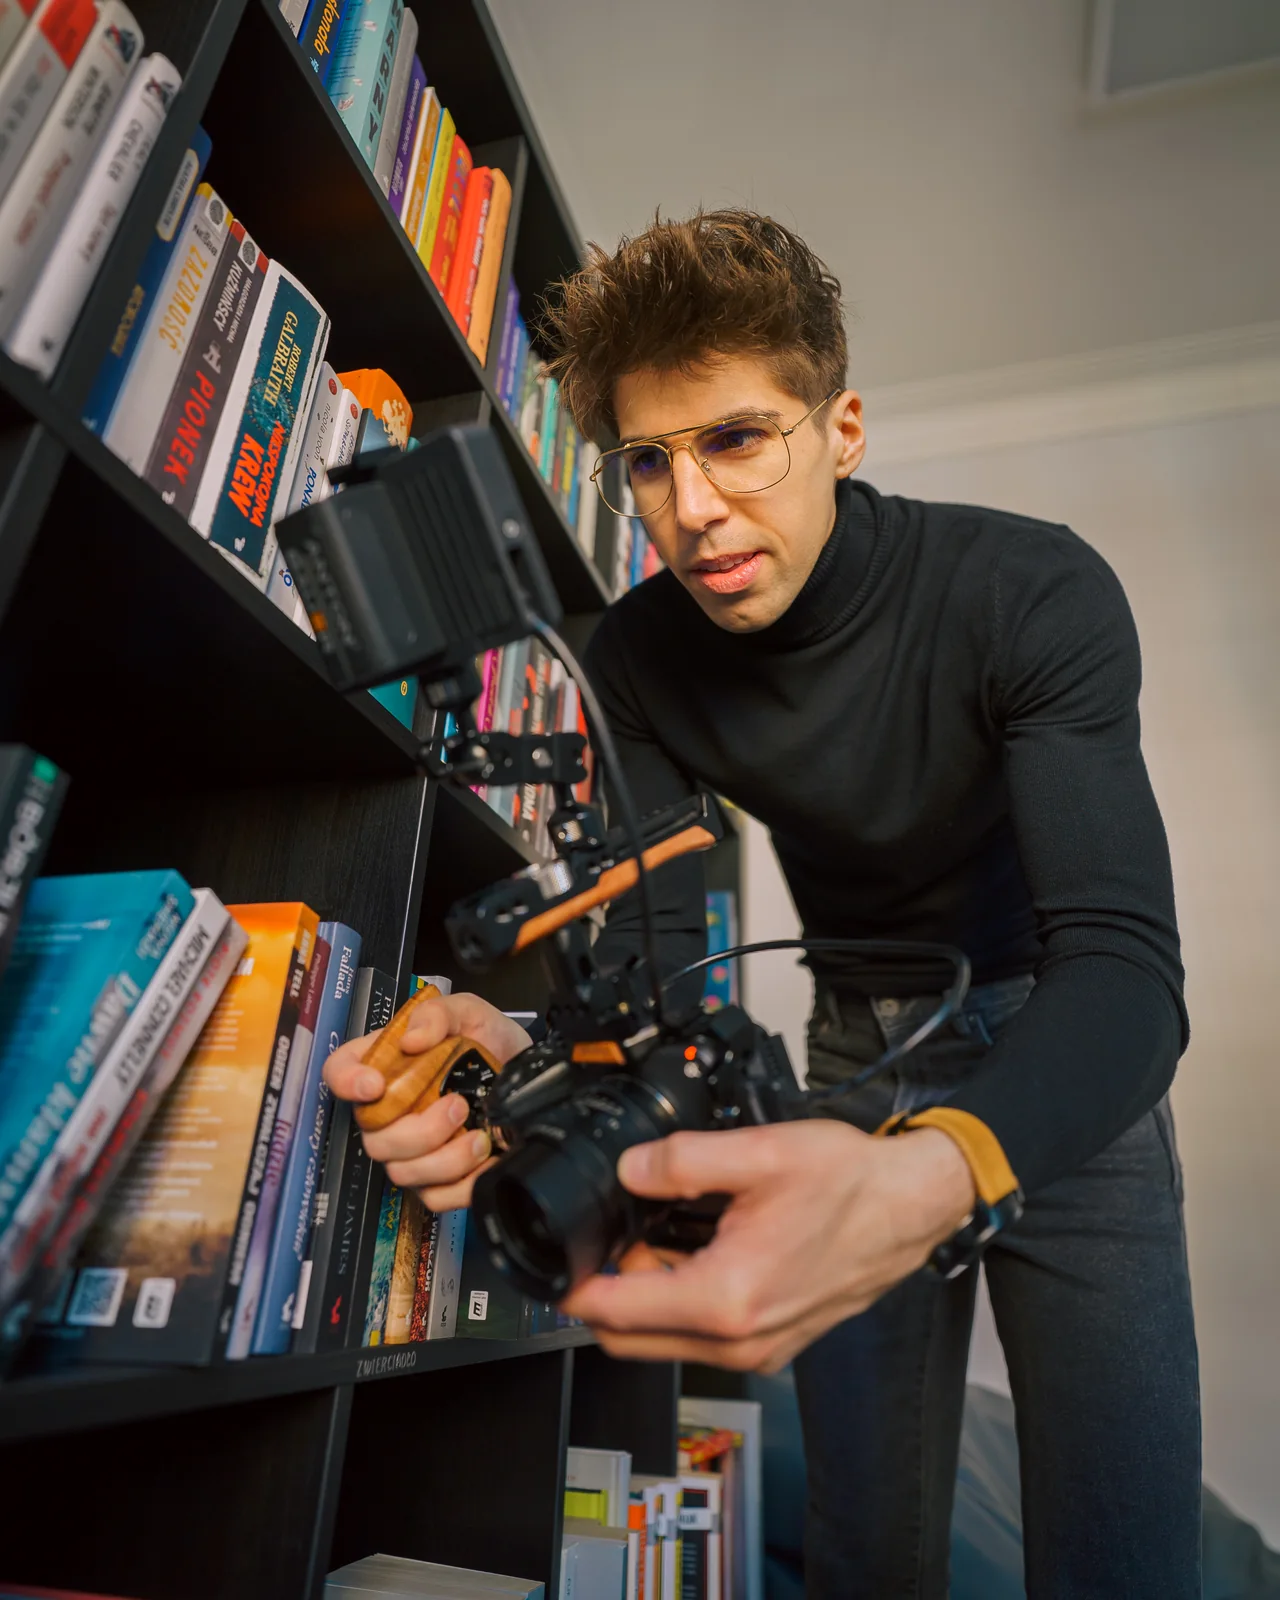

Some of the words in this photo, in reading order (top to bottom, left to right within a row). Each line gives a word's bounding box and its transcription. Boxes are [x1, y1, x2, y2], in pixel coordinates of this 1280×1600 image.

[212, 260, 243, 333] KUŹMIŃSCY
[263, 311, 299, 408] GALBRAITH
[283, 347, 302, 393] ROBERT
[164, 370, 216, 486] PIONEK
[313, 434, 324, 461] yoon
[320, 402, 332, 434] nicola
[230, 433, 264, 517] KREW
[249, 421, 283, 527] NIESPOKOJNA
[165, 923, 212, 997] MICHAEL
[290, 968, 304, 999] TELL
[334, 944, 353, 1000] Fallada
[345, 967, 355, 995] Hans
[114, 995, 172, 1084] CONNELLY
[251, 1093, 279, 1196] ZWALCZAJ
[338, 1200, 357, 1276] JAMES
[356, 1350, 417, 1378] ZWIERCIADŁO
